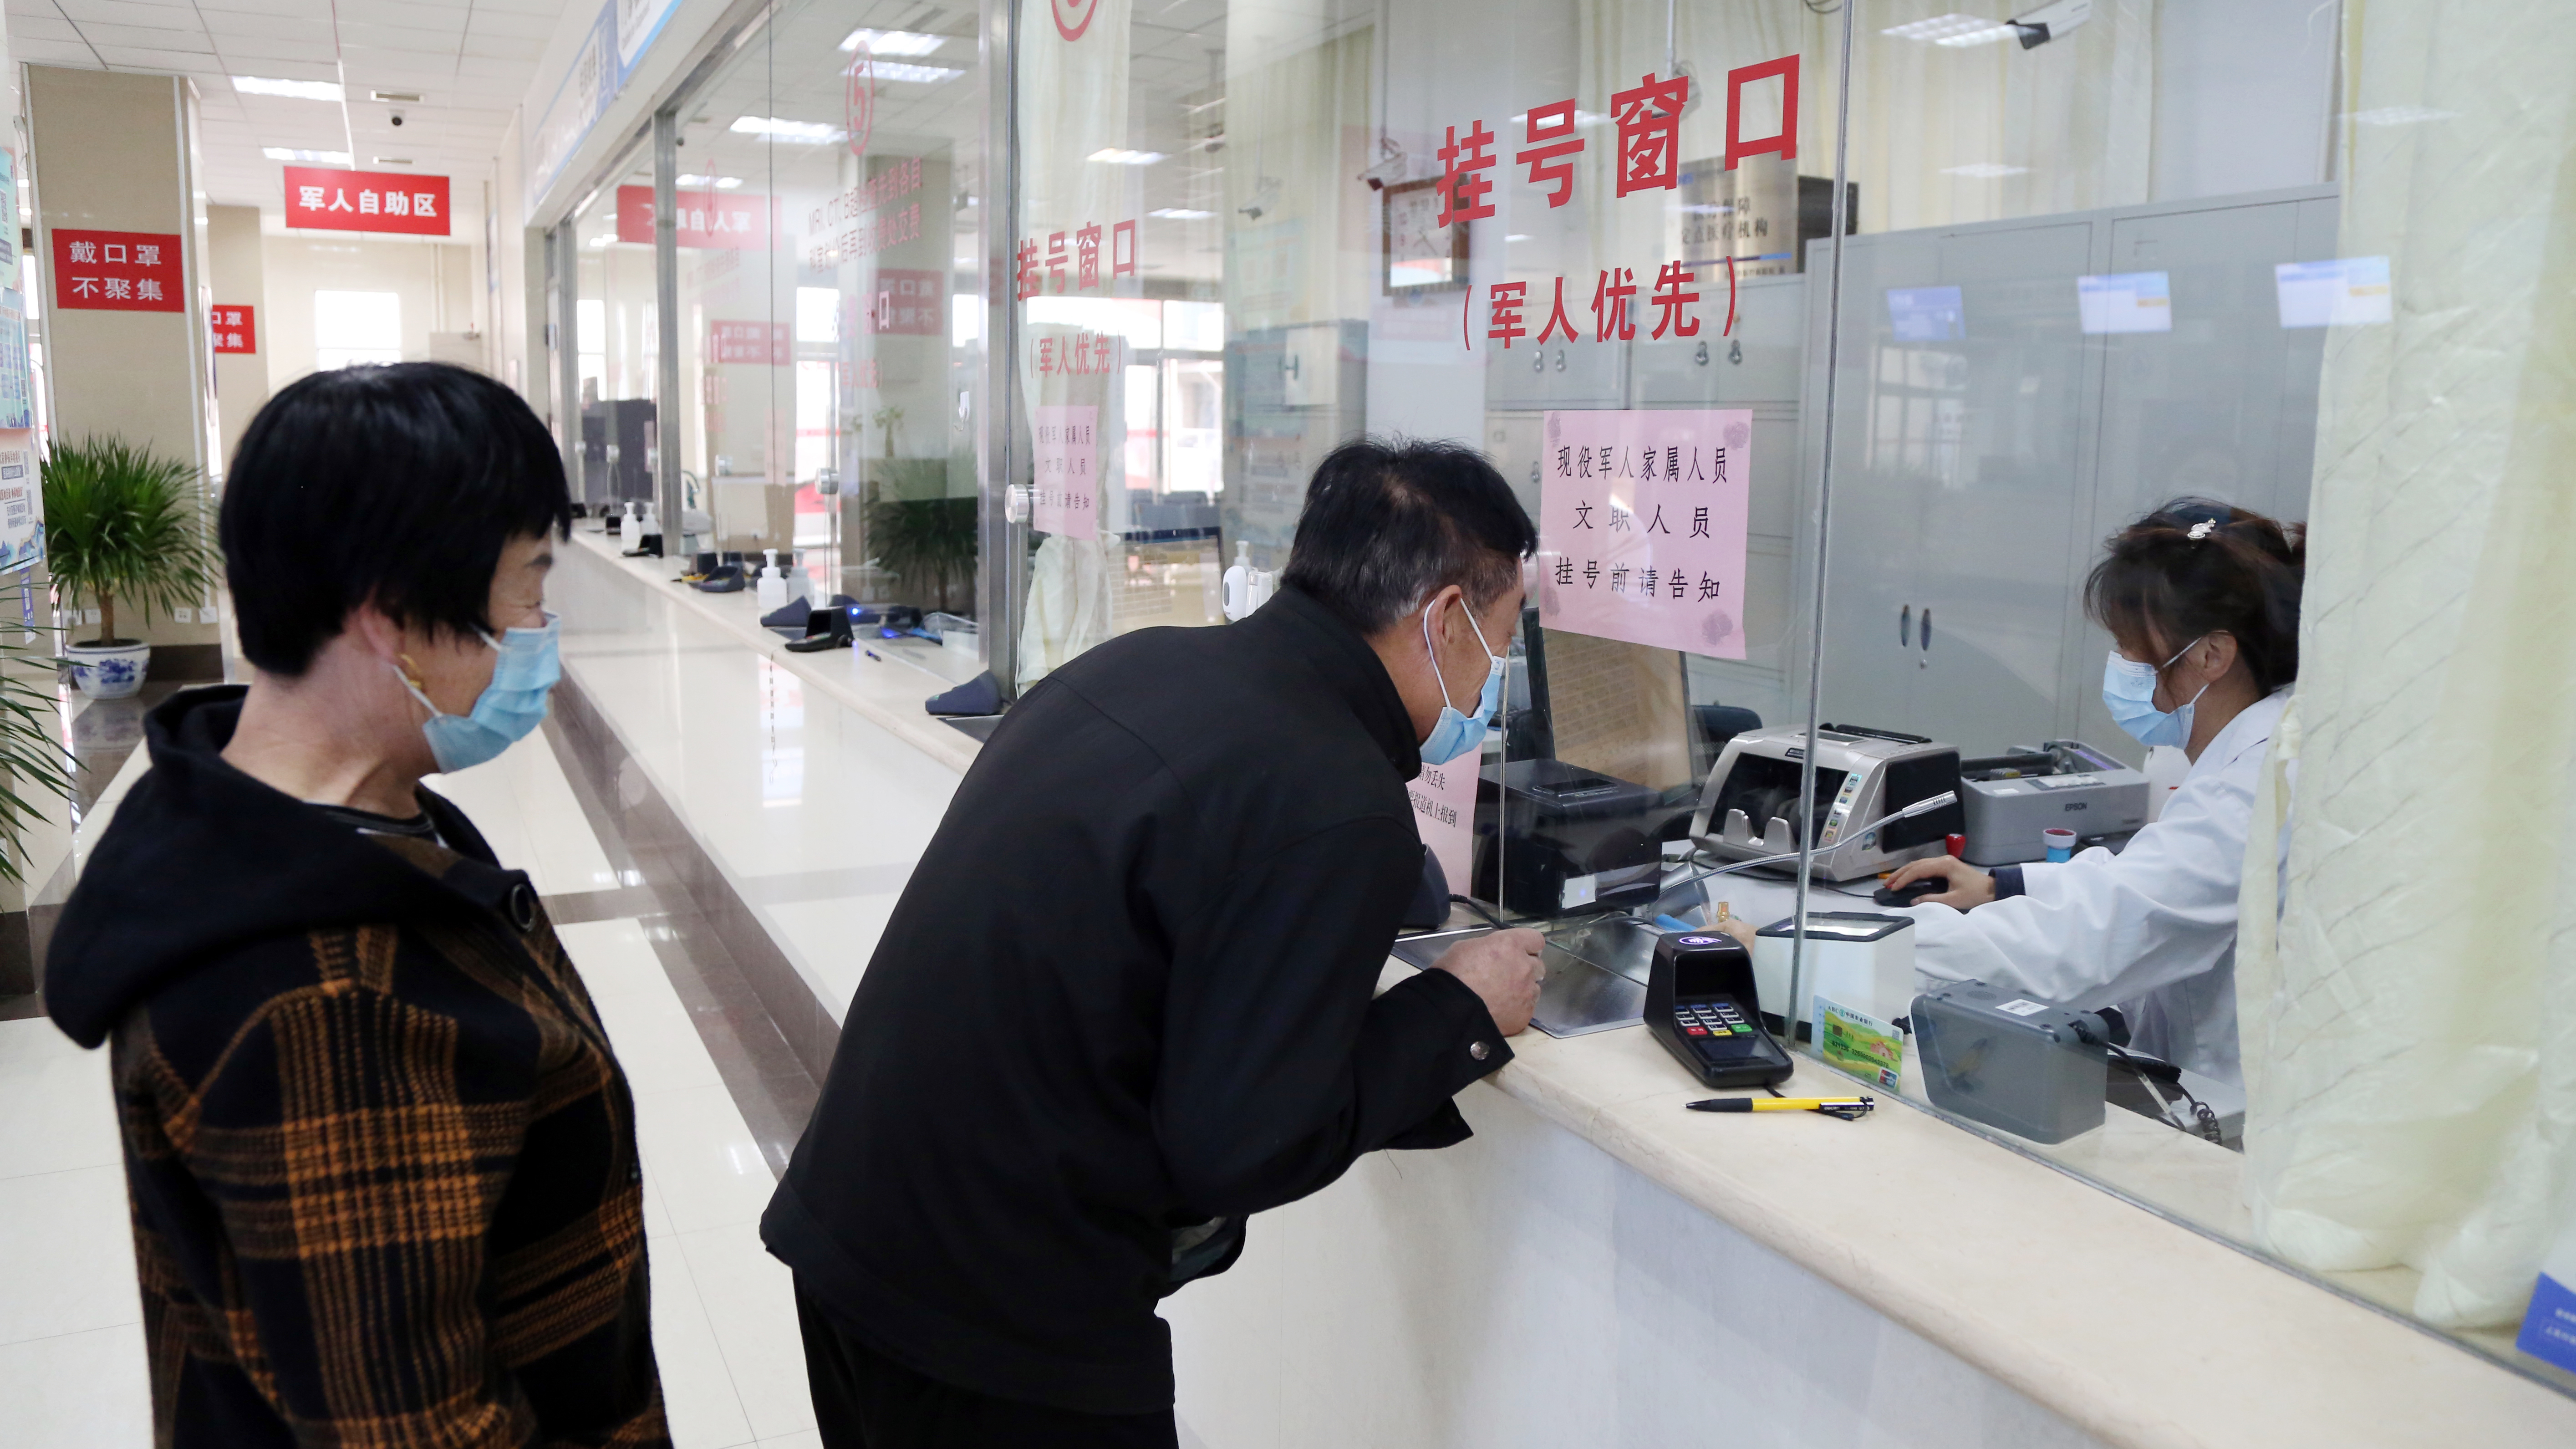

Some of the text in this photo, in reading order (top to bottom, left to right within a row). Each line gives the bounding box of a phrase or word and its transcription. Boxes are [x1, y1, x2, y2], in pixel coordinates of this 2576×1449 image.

[1436, 54, 1800, 228] 挂号窗口
[299, 185, 437, 218] 军人自助区
[70, 240, 162, 266] 戴口罩
[1017, 219, 1135, 301] 挂号窗口
[72, 277, 164, 301] 不聚集
[1039, 425, 1091, 445] 现役军人家属人员
[1045, 459, 1086, 475] 文职人员
[1557, 445, 1727, 484] 现役军人家属人员
[1040, 490, 1089, 510] 挂号前请告知
[1573, 500, 1710, 538] 文职人员
[1555, 556, 1720, 602] 挂号前请告知
[2065, 802, 2087, 811] EPSON
[1846, 1011, 1873, 1026] 中国农业银行
